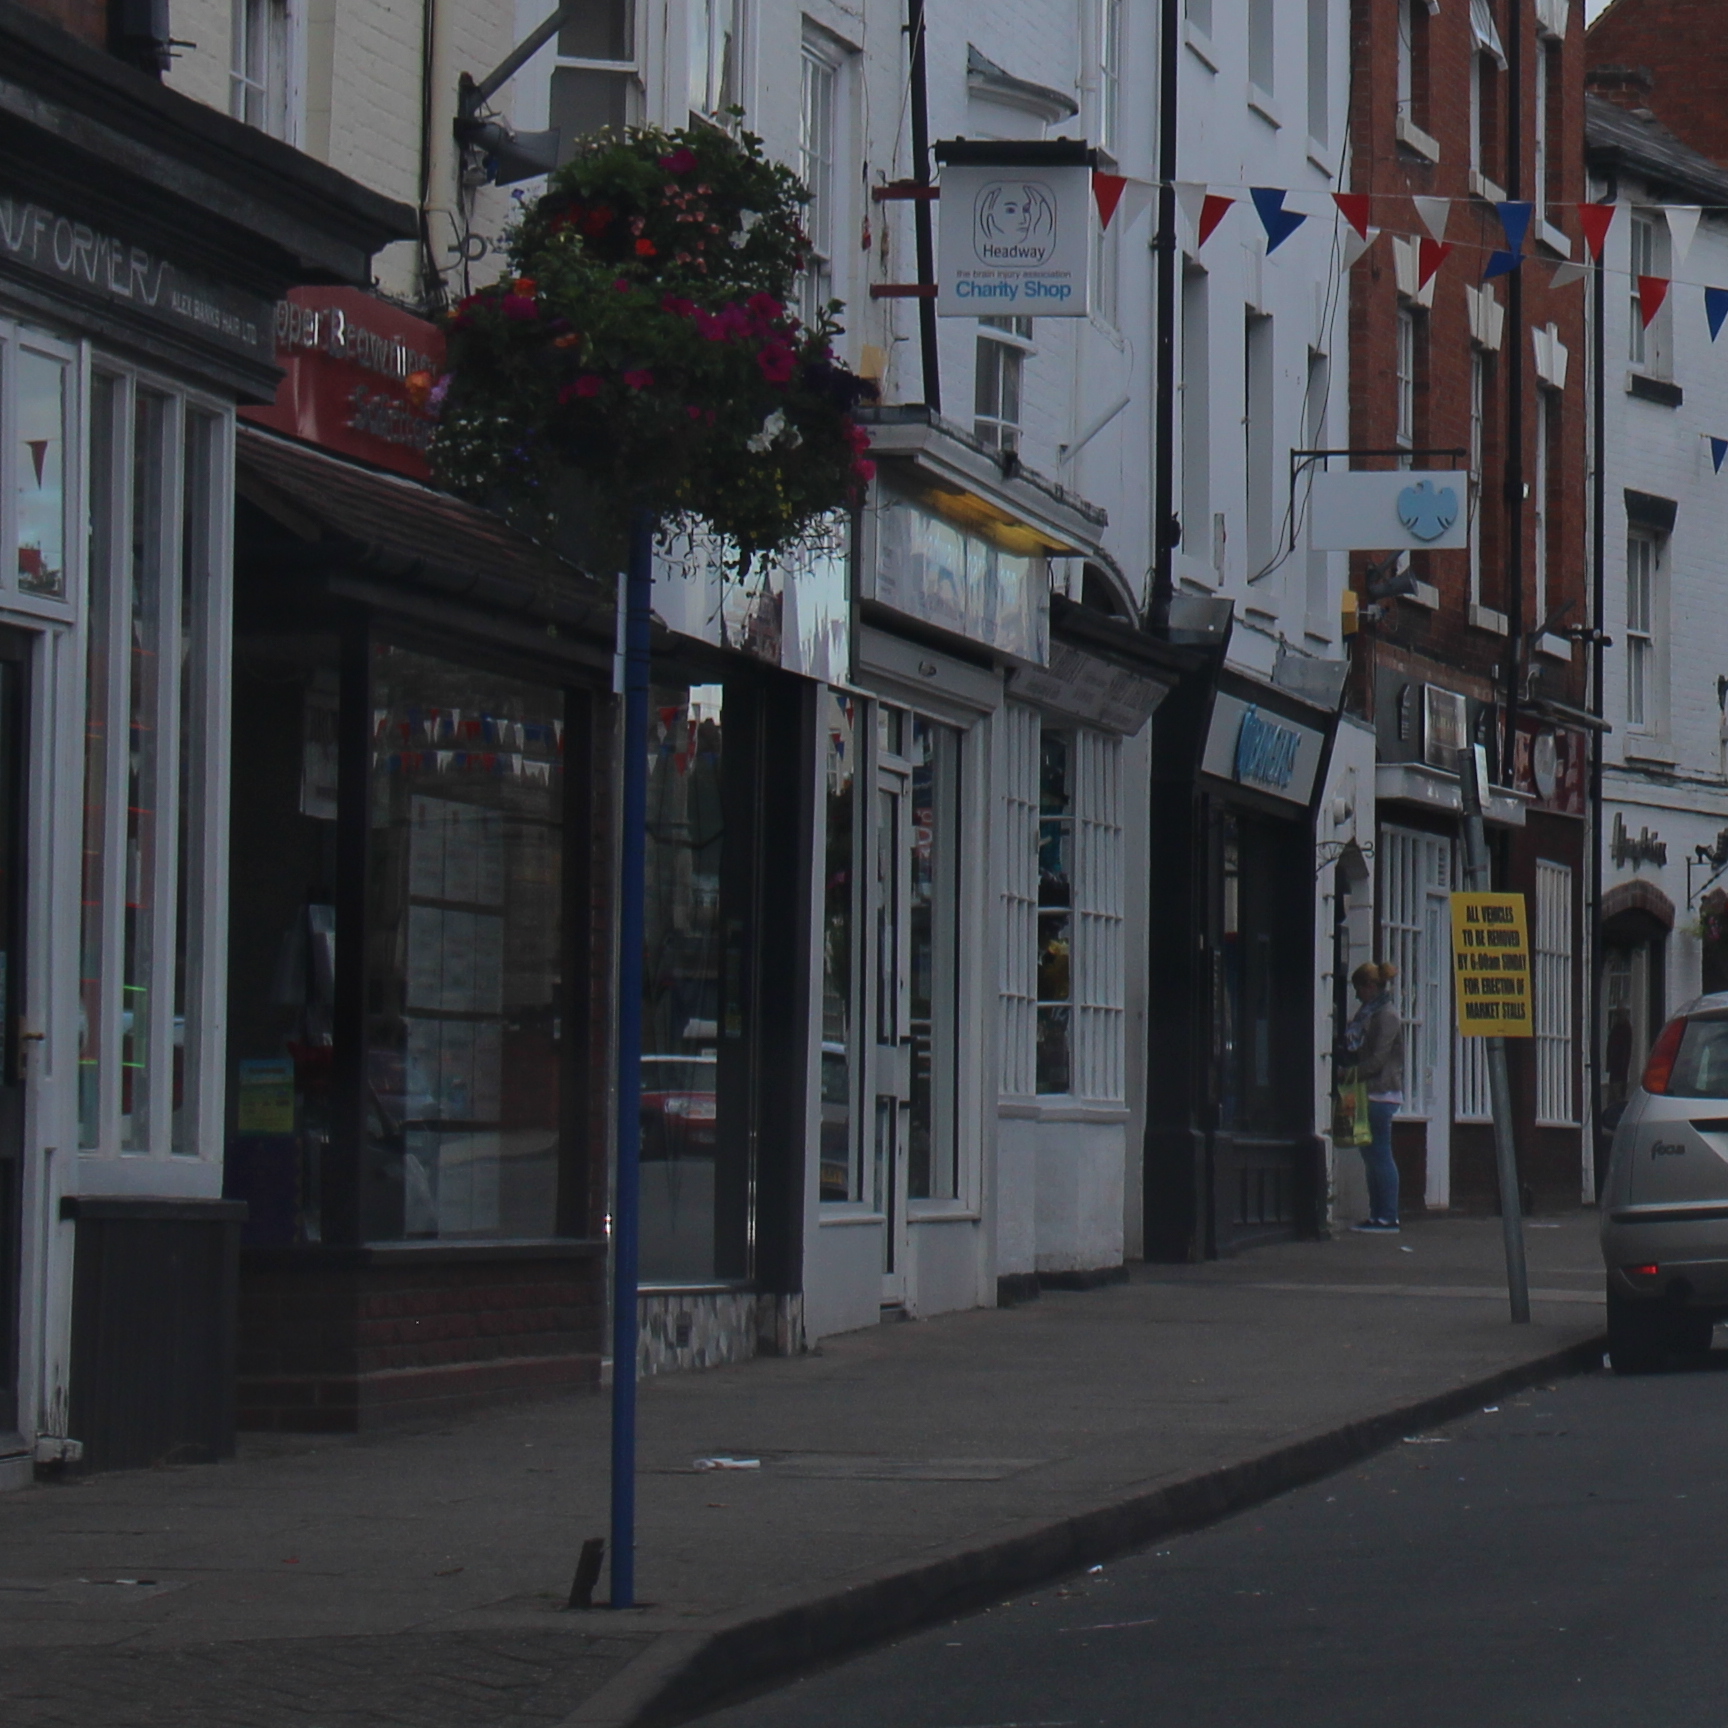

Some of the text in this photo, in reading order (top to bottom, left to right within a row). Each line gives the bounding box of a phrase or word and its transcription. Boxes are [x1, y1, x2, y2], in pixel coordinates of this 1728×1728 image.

[983, 244, 1046, 262] Headway
[973, 270, 995, 278] brain
[997, 270, 1021, 280] injury
[1023, 270, 1071, 278] association
[956, 280, 1071, 301] Charity Shop
[1466, 906, 1514, 923] ALL VEHICLES
[1463, 929, 1520, 948] TO BE REMOVED
[1457, 953, 1468, 971] BY
[1502, 953, 1527, 971] SUNDAY
[1464, 977, 1525, 995] FOR ERECTION OF
[1465, 1002, 1526, 1020] MARKET STALLS
